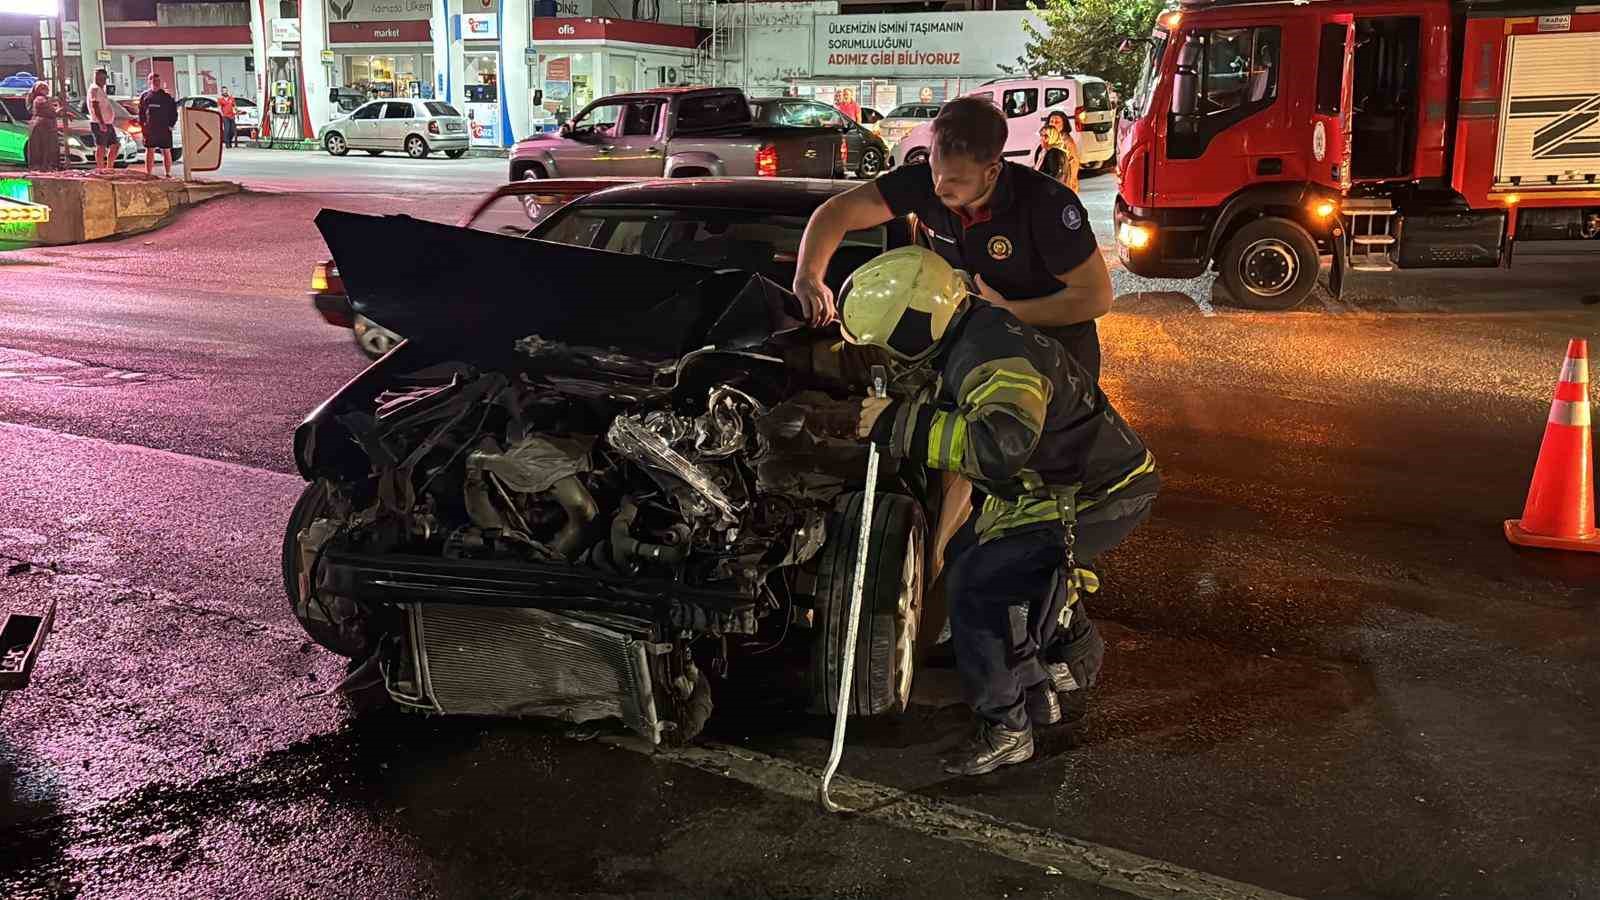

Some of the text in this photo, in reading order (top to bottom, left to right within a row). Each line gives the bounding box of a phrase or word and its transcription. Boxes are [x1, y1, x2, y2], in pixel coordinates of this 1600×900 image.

[374, 28, 400, 37] market
[558, 24, 575, 35] ofis
[828, 20, 964, 35] ÜLKEMİZİN İSMİNİ TAŞIMANIN
[828, 37, 913, 49] SORUMLULUĞUNU
[828, 50, 960, 65] ADIMIZ GİBİ BİLİYORUZ
